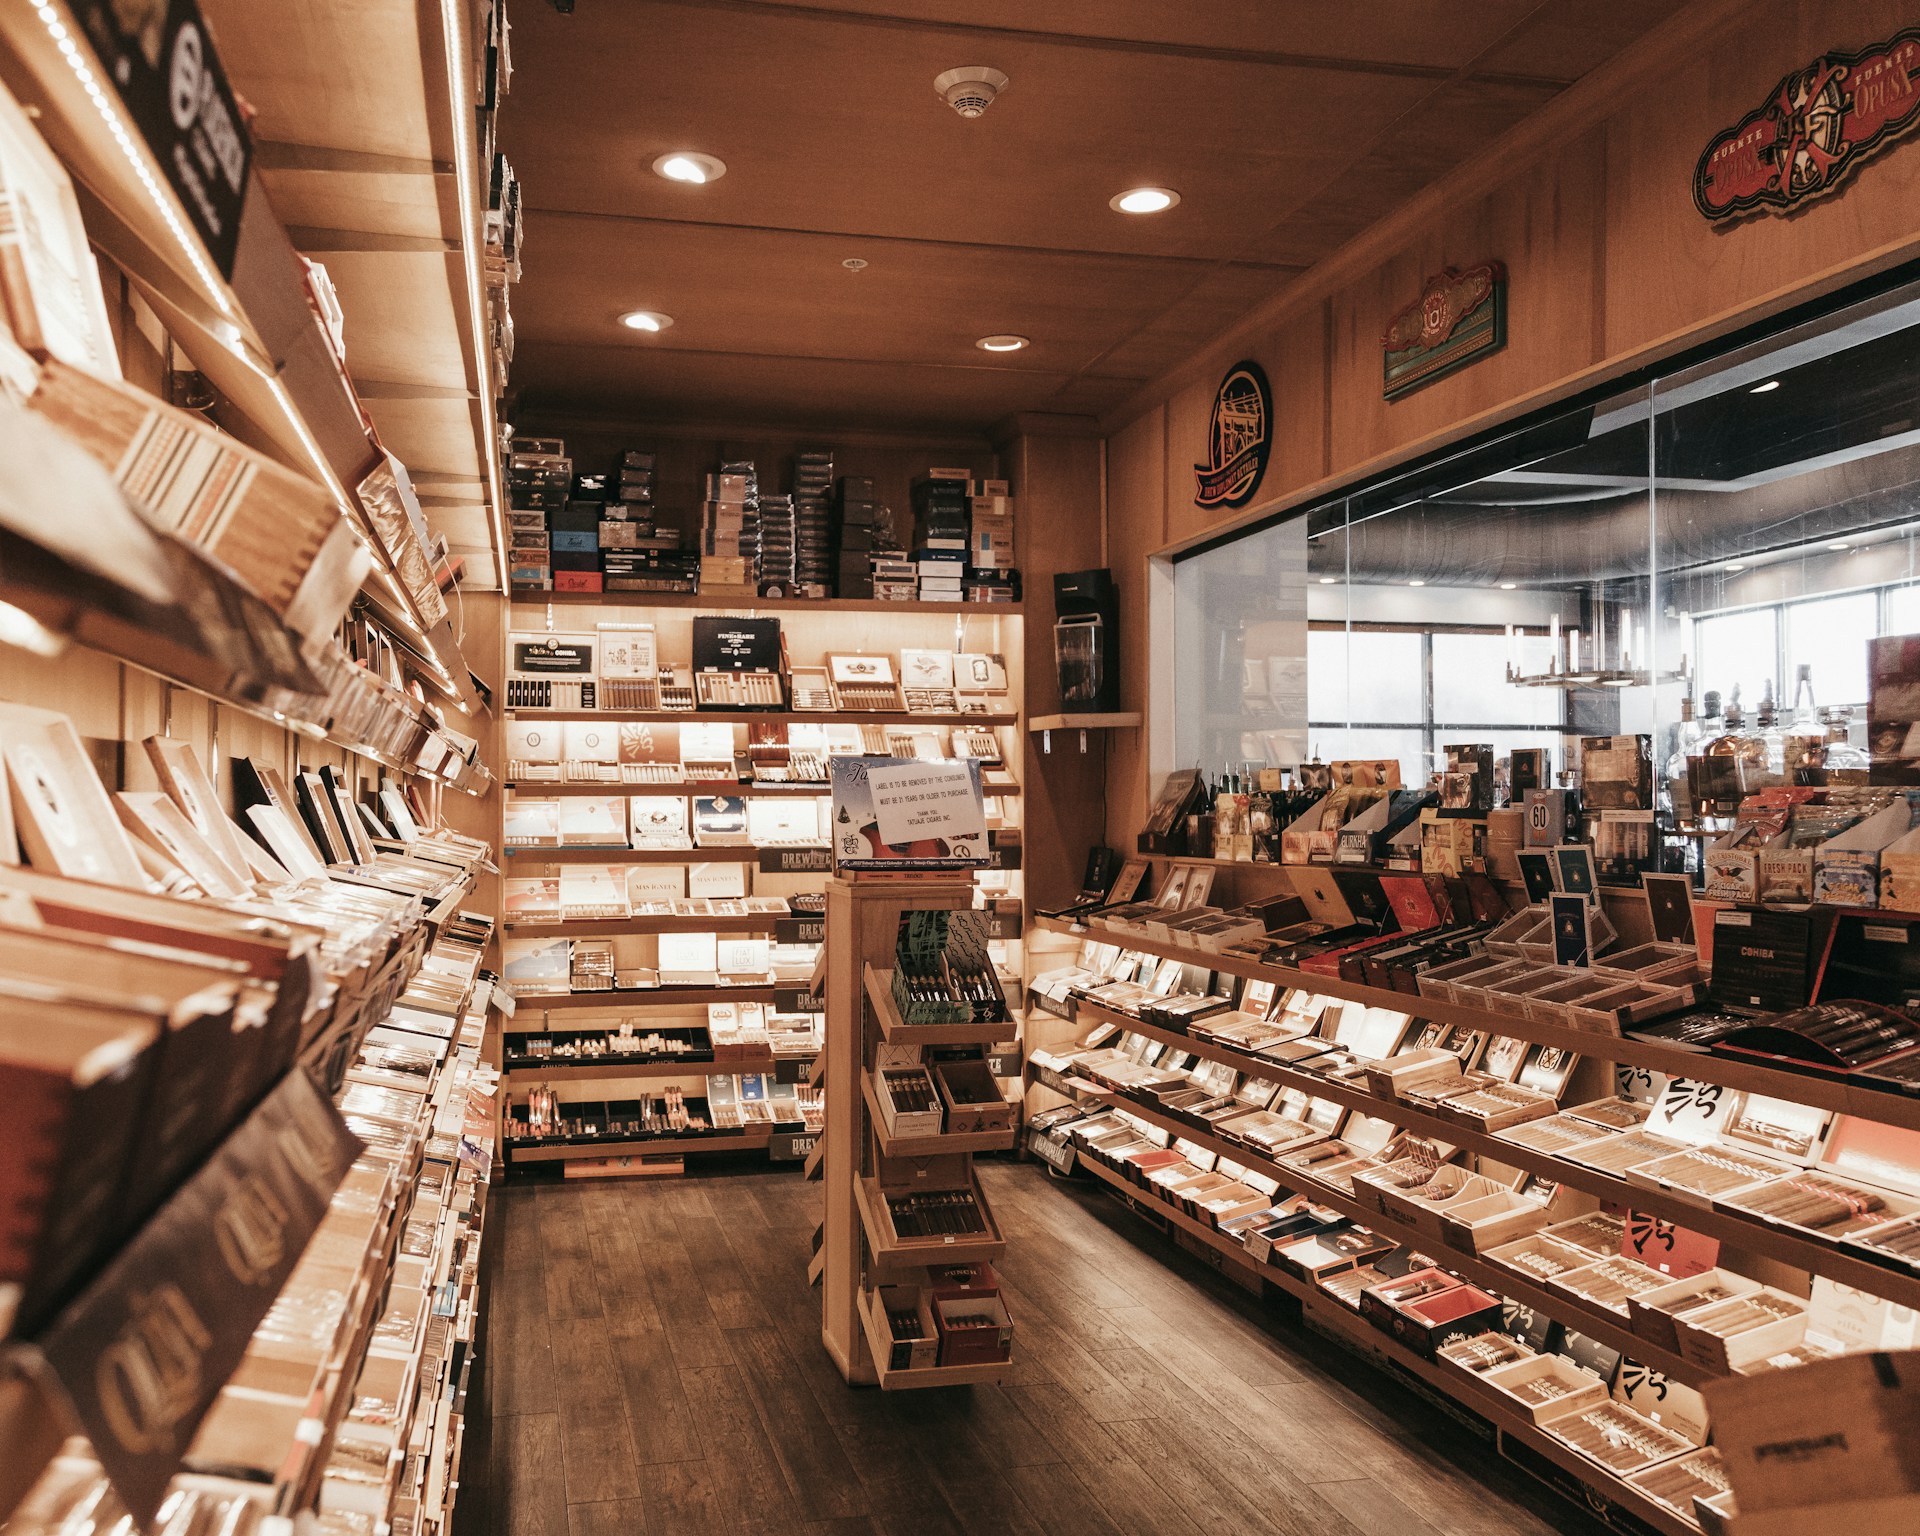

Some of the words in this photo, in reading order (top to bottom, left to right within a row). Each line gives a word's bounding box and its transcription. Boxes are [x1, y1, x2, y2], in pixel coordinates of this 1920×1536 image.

[1856, 45, 1914, 86] FUENTE
[1854, 58, 1914, 119] OPUSX
[1713, 129, 1763, 162] FUENTE
[1715, 143, 1763, 191] OPUSX
[908, 779, 927, 787] REMOVED
[944, 773, 966, 782] CONSUMER
[880, 797, 891, 805] MUST
[926, 792, 940, 800] OLDER
[947, 788, 969, 797] PURCHASE
[906, 818, 925, 826] TATUAJE
[926, 816, 942, 824] CIGARS
[1533, 805, 1546, 827] 60
[1341, 834, 1367, 848] GURKHA
[782, 853, 810, 864] DREW
[1716, 852, 1752, 866] CRISTOBAL
[1763, 863, 1786, 874] FRESH
[1788, 862, 1808, 874] PACK
[1719, 882, 1741, 890] CIGAR
[1836, 882, 1860, 892] CIGAR
[1708, 890, 1729, 898] FRESH
[1731, 891, 1752, 900] PACK
[1741, 947, 1775, 959] COHIBA
[735, 957, 751, 965] LUX
[944, 1269, 977, 1277] PUNCH
